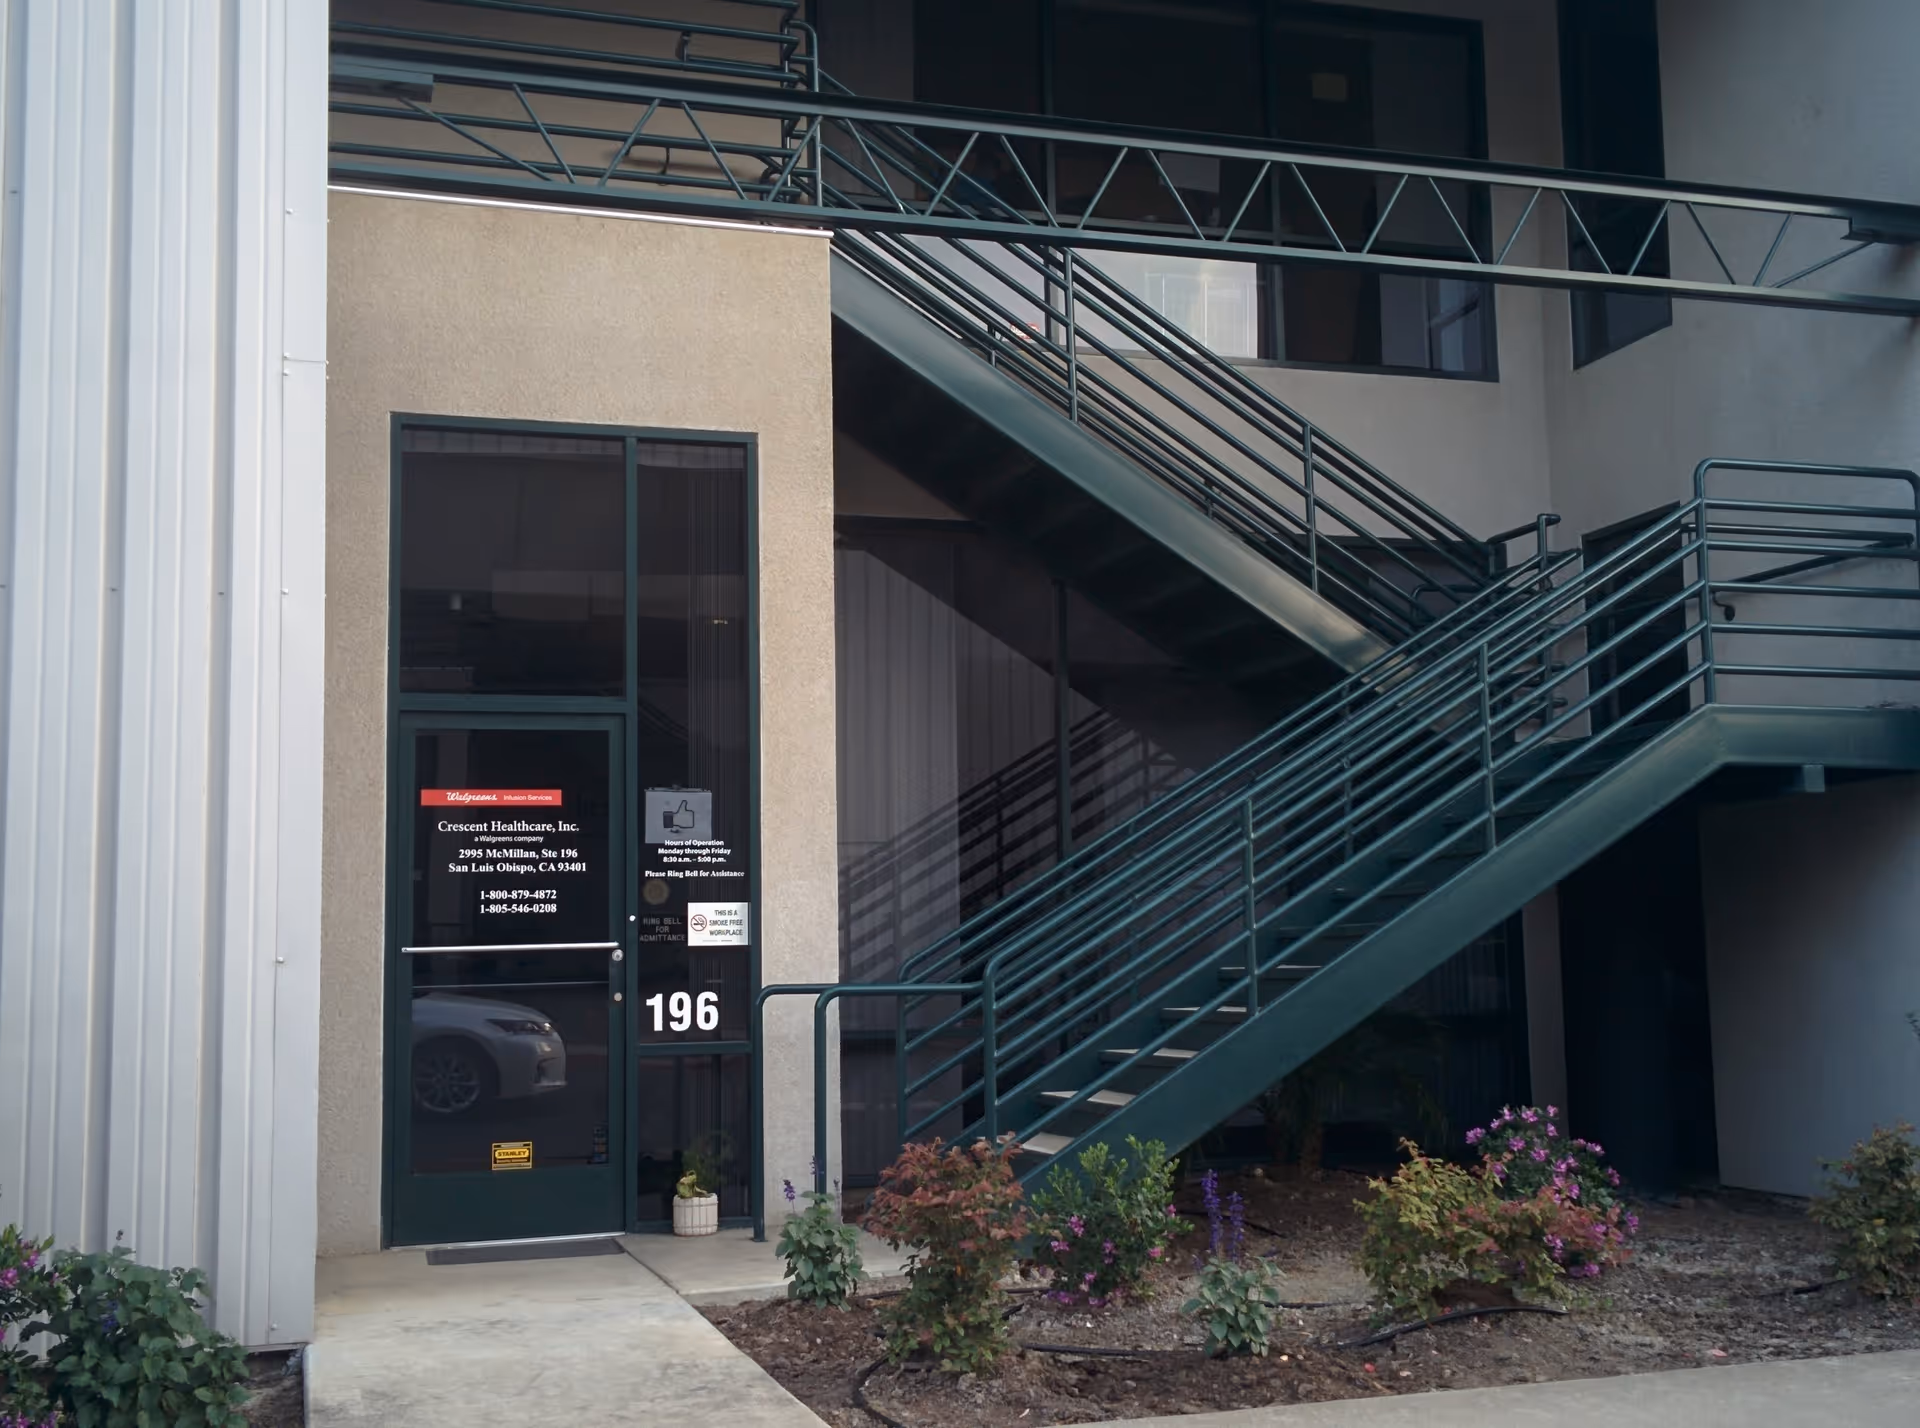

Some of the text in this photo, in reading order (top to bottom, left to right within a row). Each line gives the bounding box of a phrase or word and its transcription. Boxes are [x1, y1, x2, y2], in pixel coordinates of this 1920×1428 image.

[446, 792, 498, 803] Walgreens
[437, 820, 580, 833] Crescent Healthcare, Inc.
[479, 835, 513, 843] Walgreens
[692, 839, 725, 847] Operation
[458, 848, 578, 860] 2995 McMillan, Ste 196
[448, 862, 587, 874] San Luis Obispo, CA 93401
[667, 870, 684, 878] Ring
[480, 889, 557, 900] 1-800-879-4872
[480, 903, 557, 914] 1-805-546-0208
[643, 918, 660, 926] RING
[640, 934, 685, 942] ADMITTANCE
[646, 991, 719, 1032] 196
